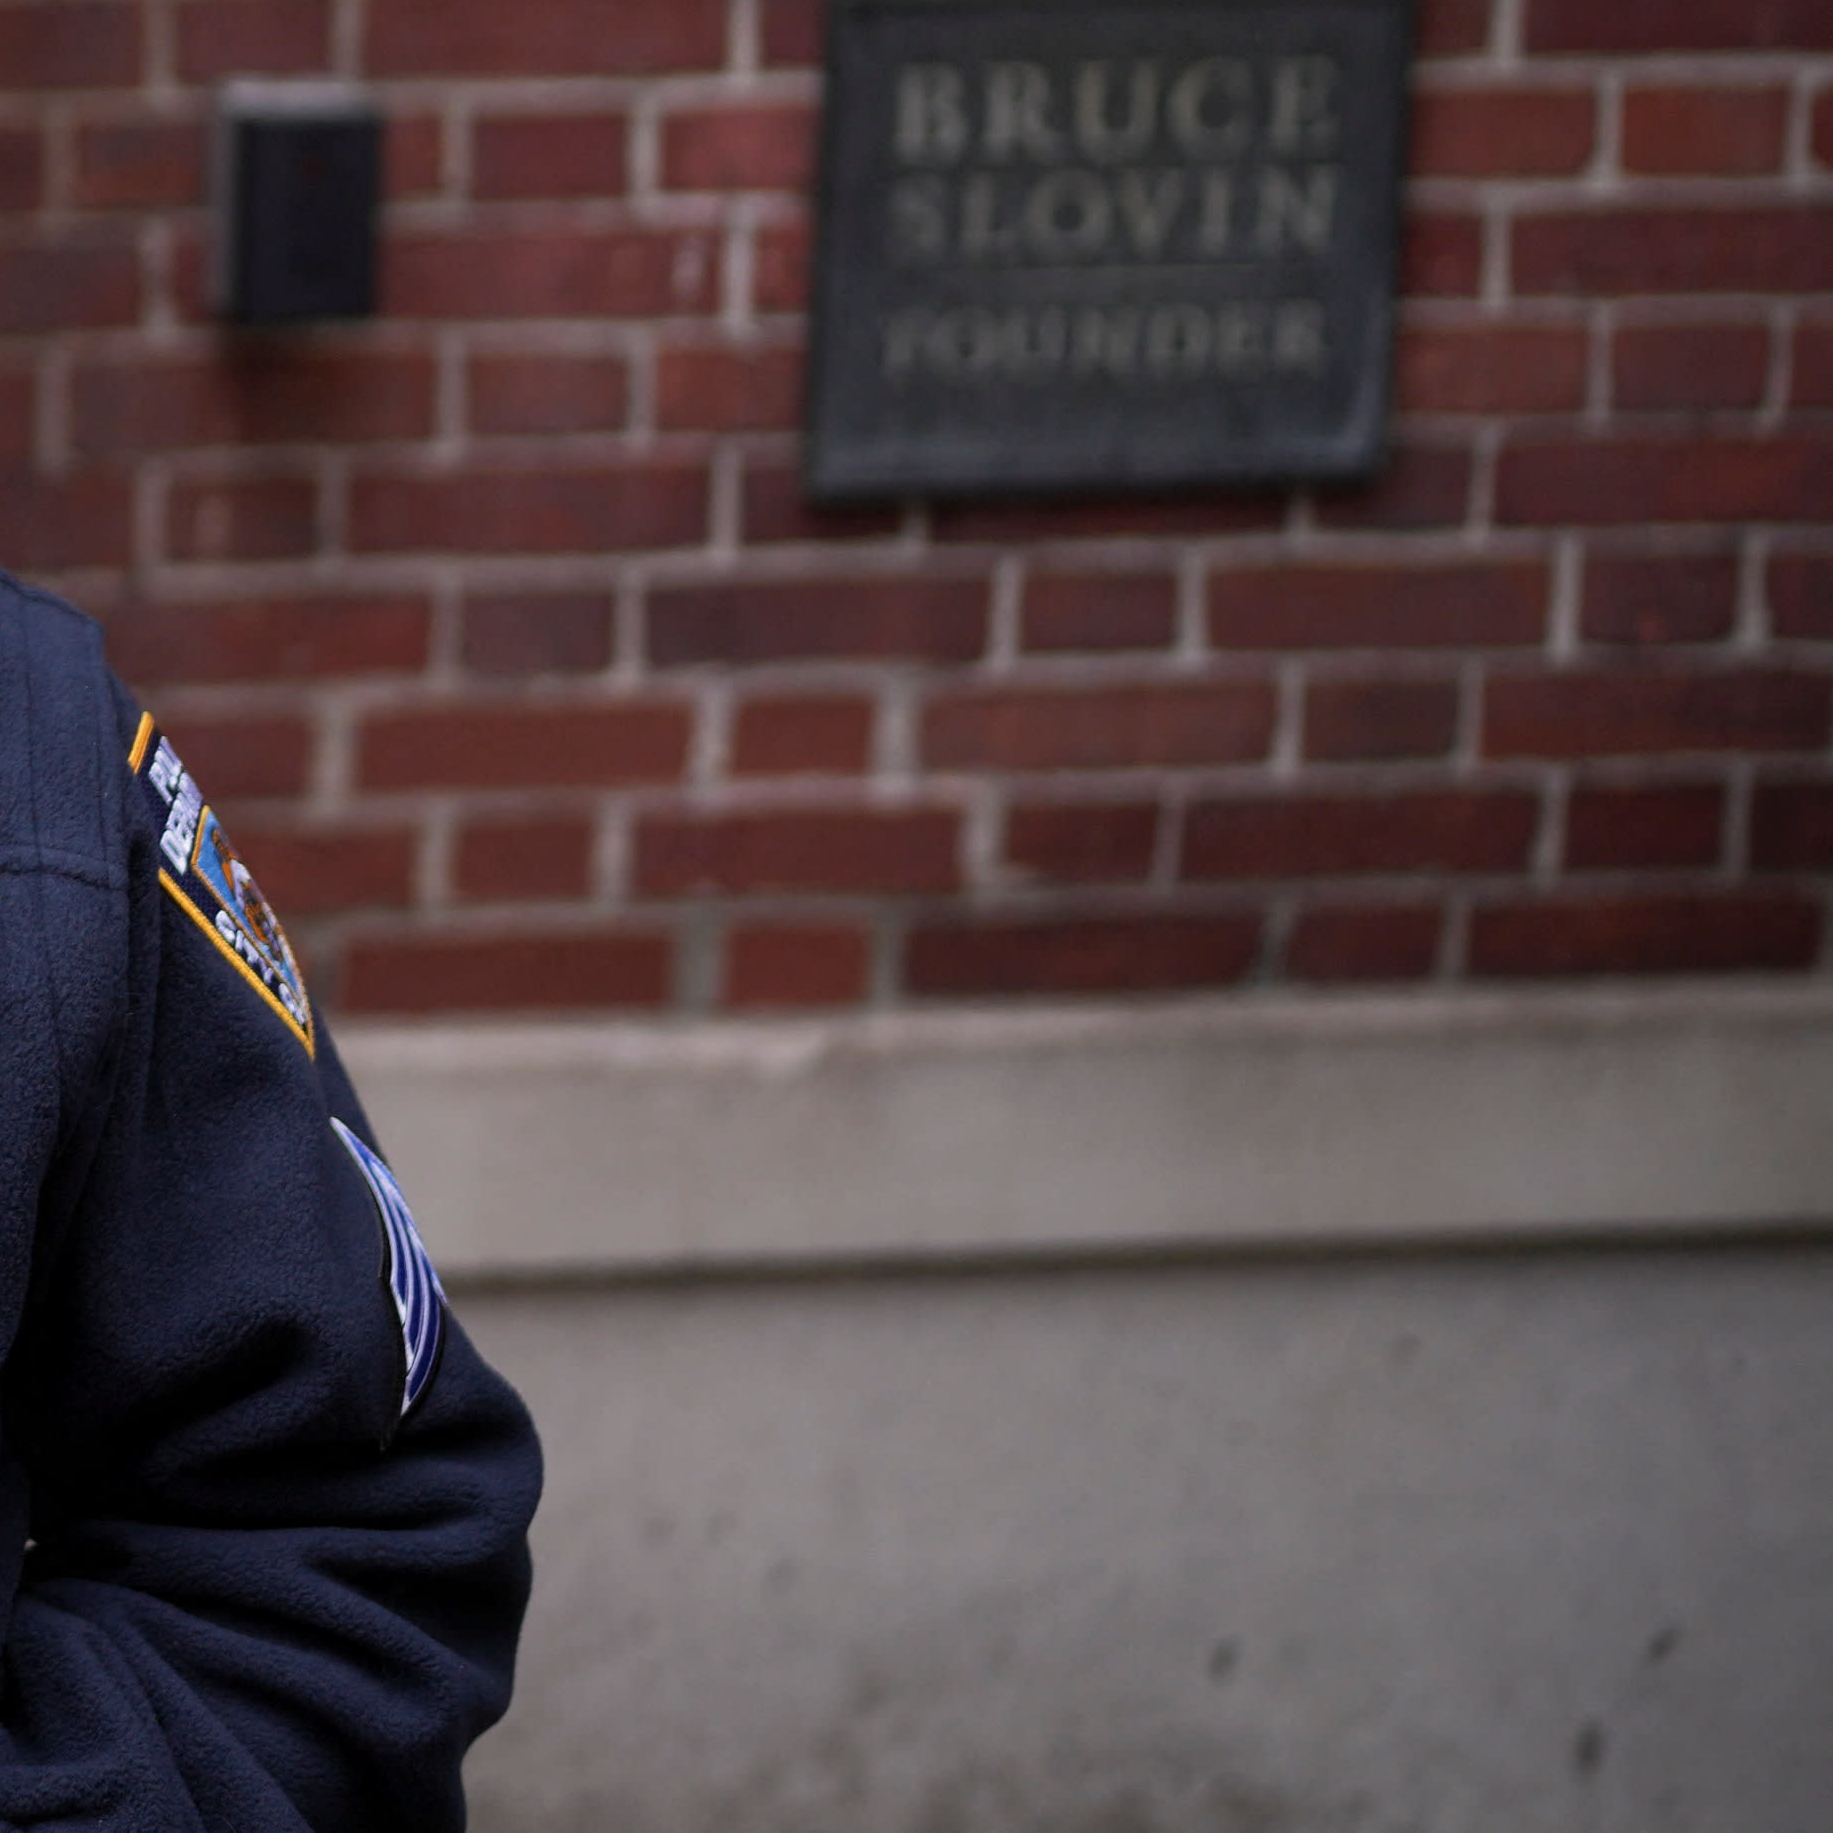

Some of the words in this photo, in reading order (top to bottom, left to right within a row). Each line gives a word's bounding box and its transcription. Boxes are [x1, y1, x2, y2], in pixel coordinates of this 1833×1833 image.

[891, 55, 1338, 165] BRUCE
[887, 165, 1337, 259] SLOVIN
[881, 297, 1331, 379] FOUNDER
